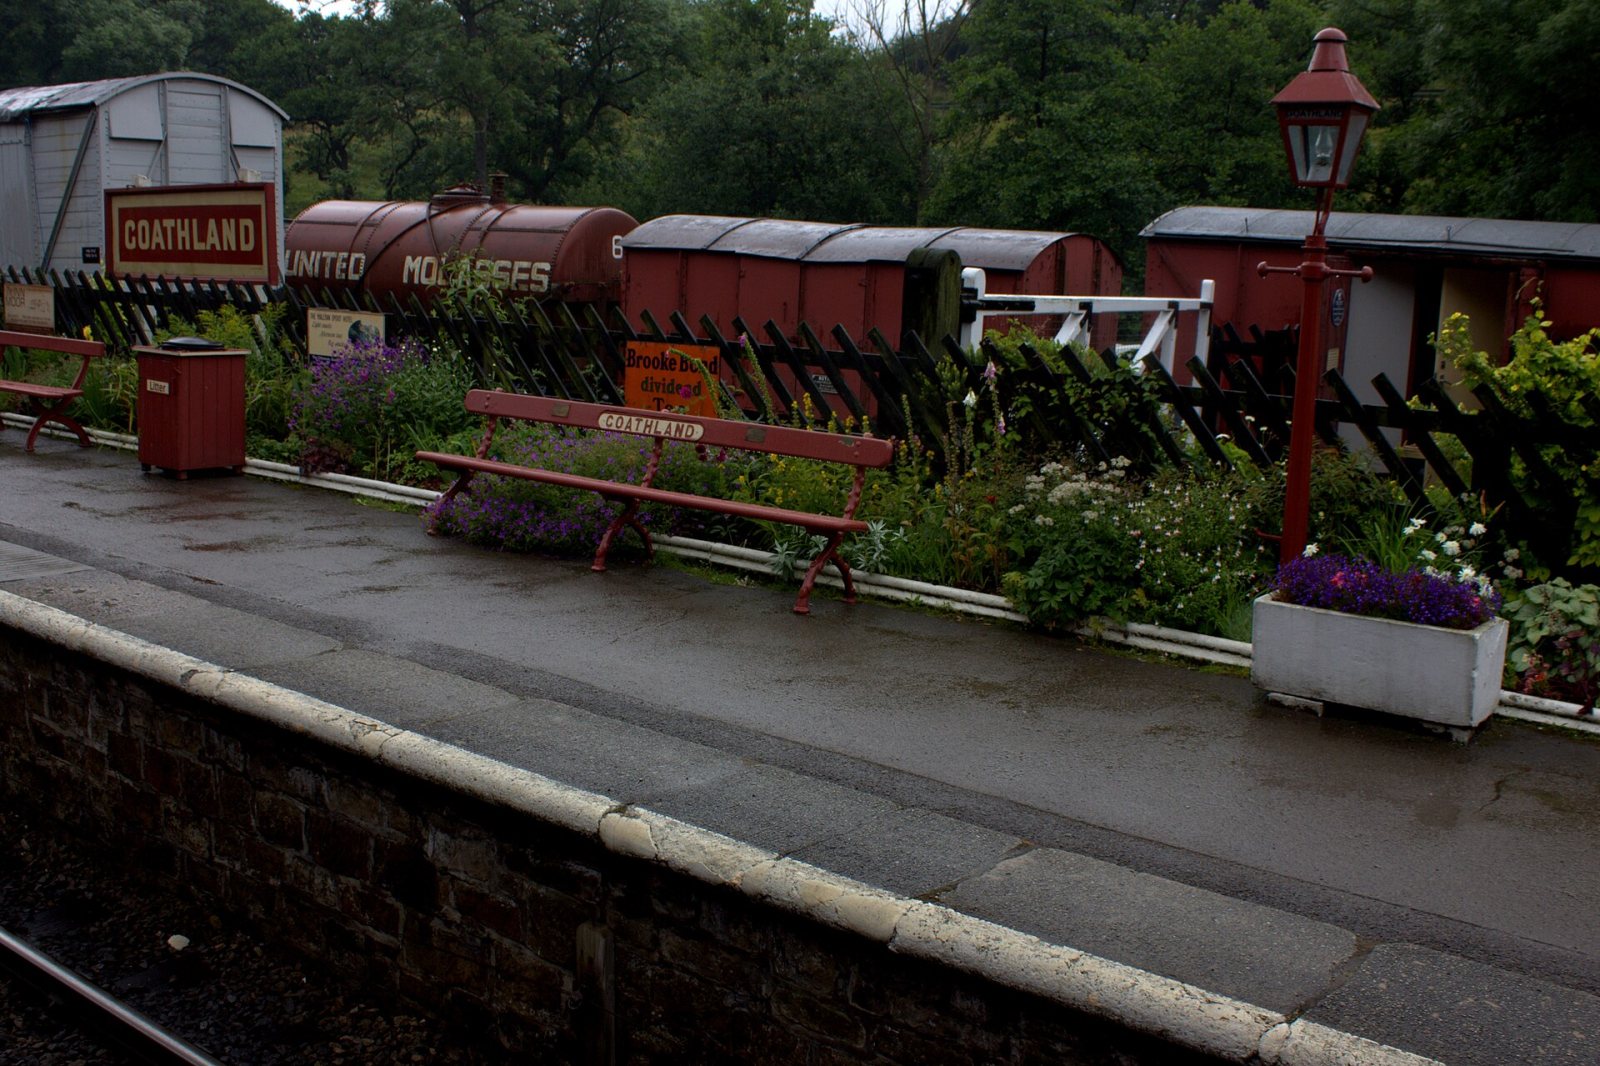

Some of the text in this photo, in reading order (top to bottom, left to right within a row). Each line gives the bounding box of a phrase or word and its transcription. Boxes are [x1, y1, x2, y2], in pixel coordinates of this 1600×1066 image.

[284, 249, 366, 281] UNITED
[626, 349, 677, 372] Brooke
[641, 375, 701, 397] divided
[652, 397, 686, 412] Te
